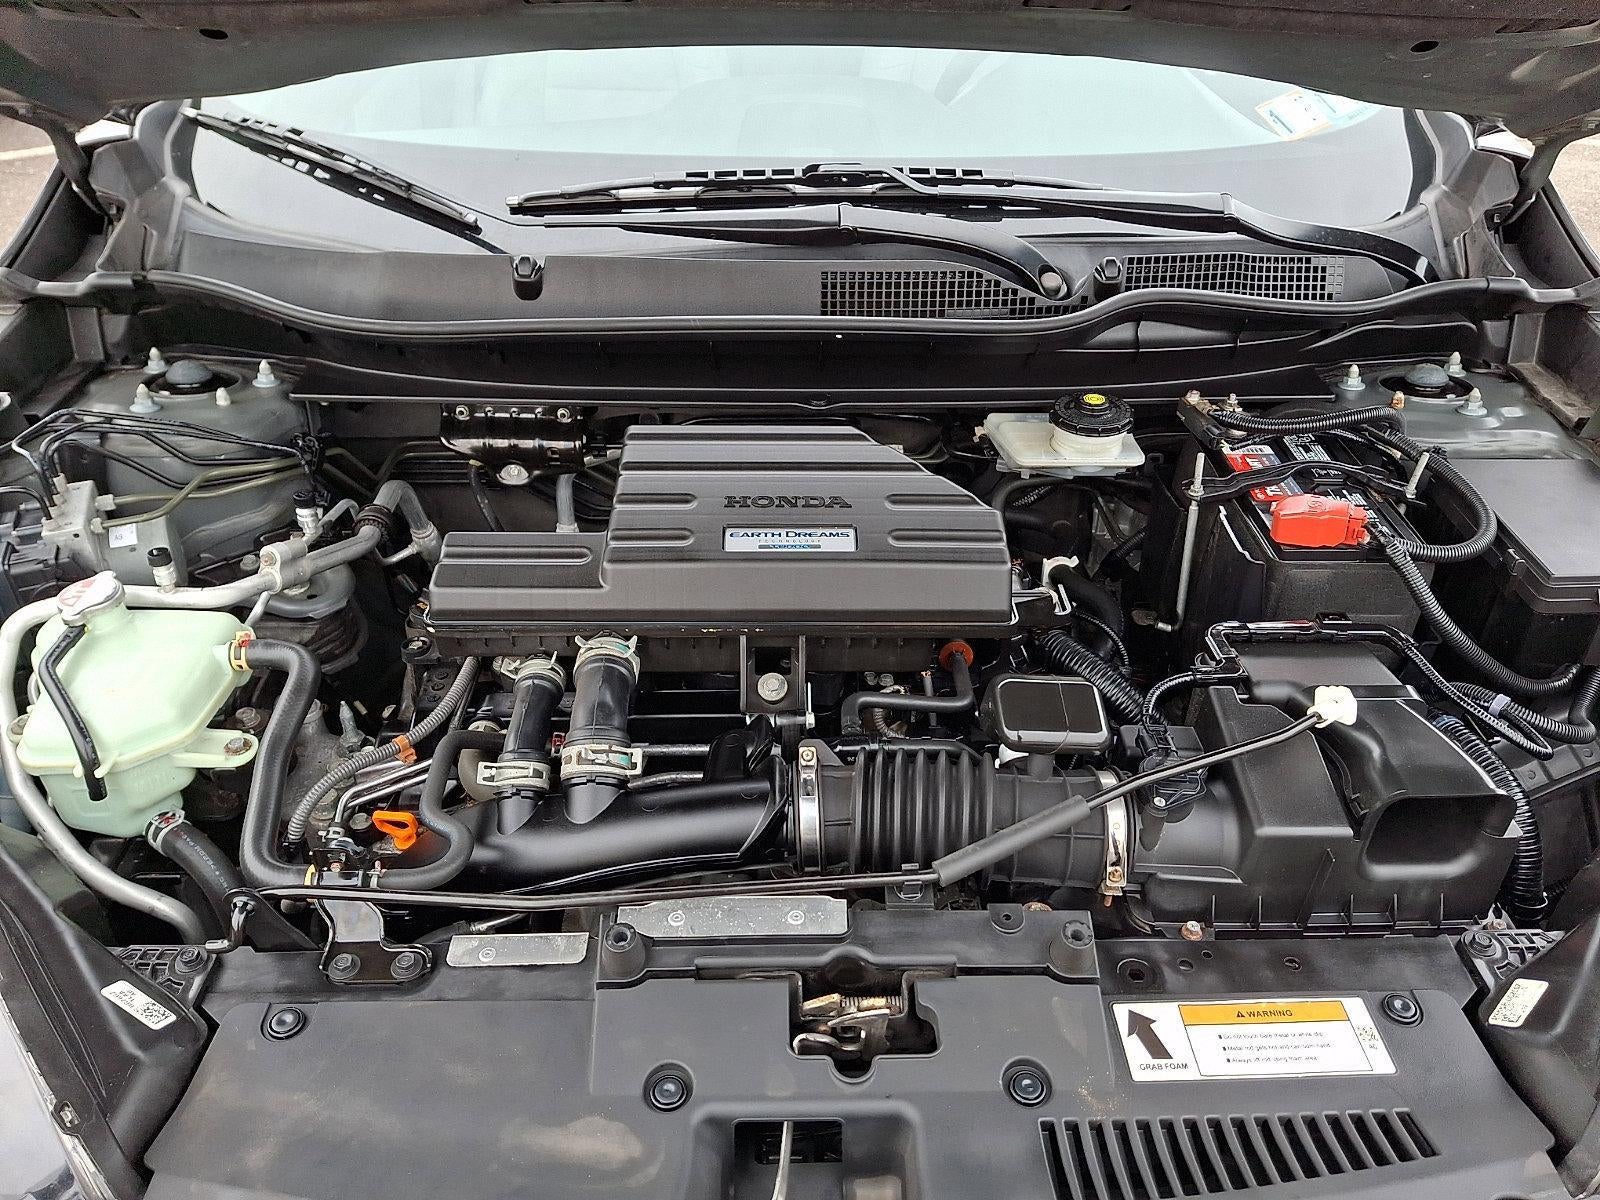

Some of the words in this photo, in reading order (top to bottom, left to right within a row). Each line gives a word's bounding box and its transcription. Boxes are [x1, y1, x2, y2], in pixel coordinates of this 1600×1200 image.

[724, 495, 852, 508] HONDA
[785, 530, 850, 538] DREAMS
[1246, 1009, 1293, 1018] WARNING
[1139, 1063, 1163, 1071] GRAB
[1165, 1062, 1189, 1070] FOAM
